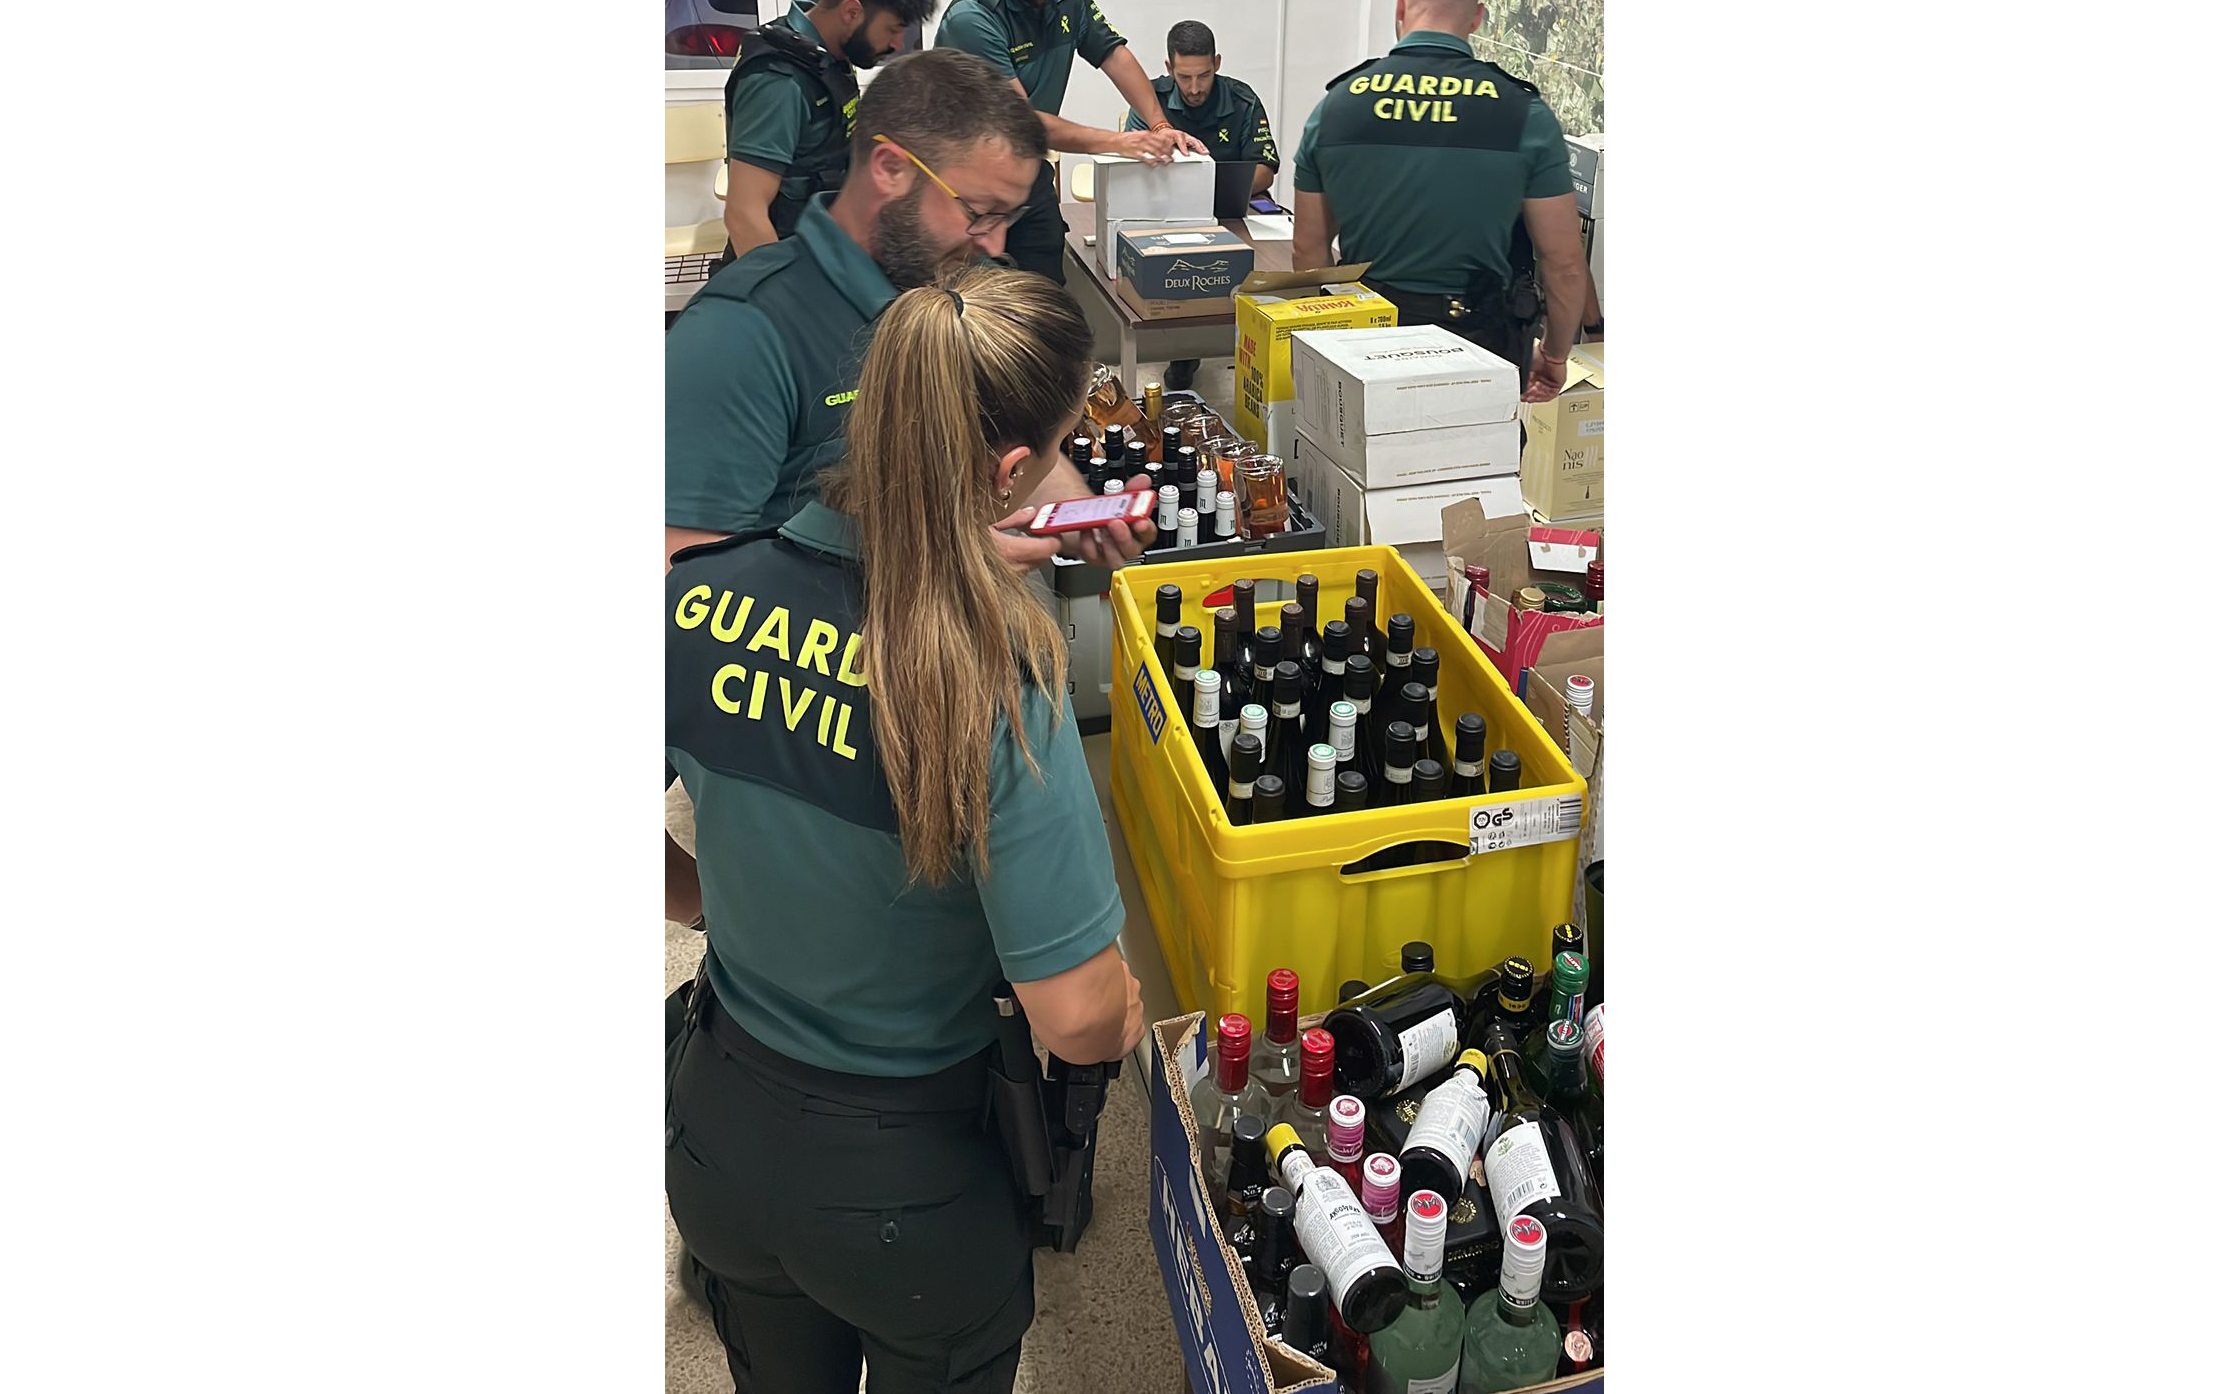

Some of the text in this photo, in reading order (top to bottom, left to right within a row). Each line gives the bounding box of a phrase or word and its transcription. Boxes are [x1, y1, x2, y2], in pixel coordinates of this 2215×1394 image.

[1350, 74, 1499, 99] GUARDIA
[1374, 98, 1458, 122] CIVIL
[1165, 275, 1231, 293] DEUX ROCHES
[1364, 347, 1464, 361] BOUSQUET
[1337, 380, 1346, 448] BOUSQUET
[674, 585, 869, 687] GUARD
[711, 663, 857, 761] CIVIL
[1135, 668, 1164, 736] METRO
[1491, 807, 1514, 827] GS
[1163, 1174, 1227, 1394] HEBA
